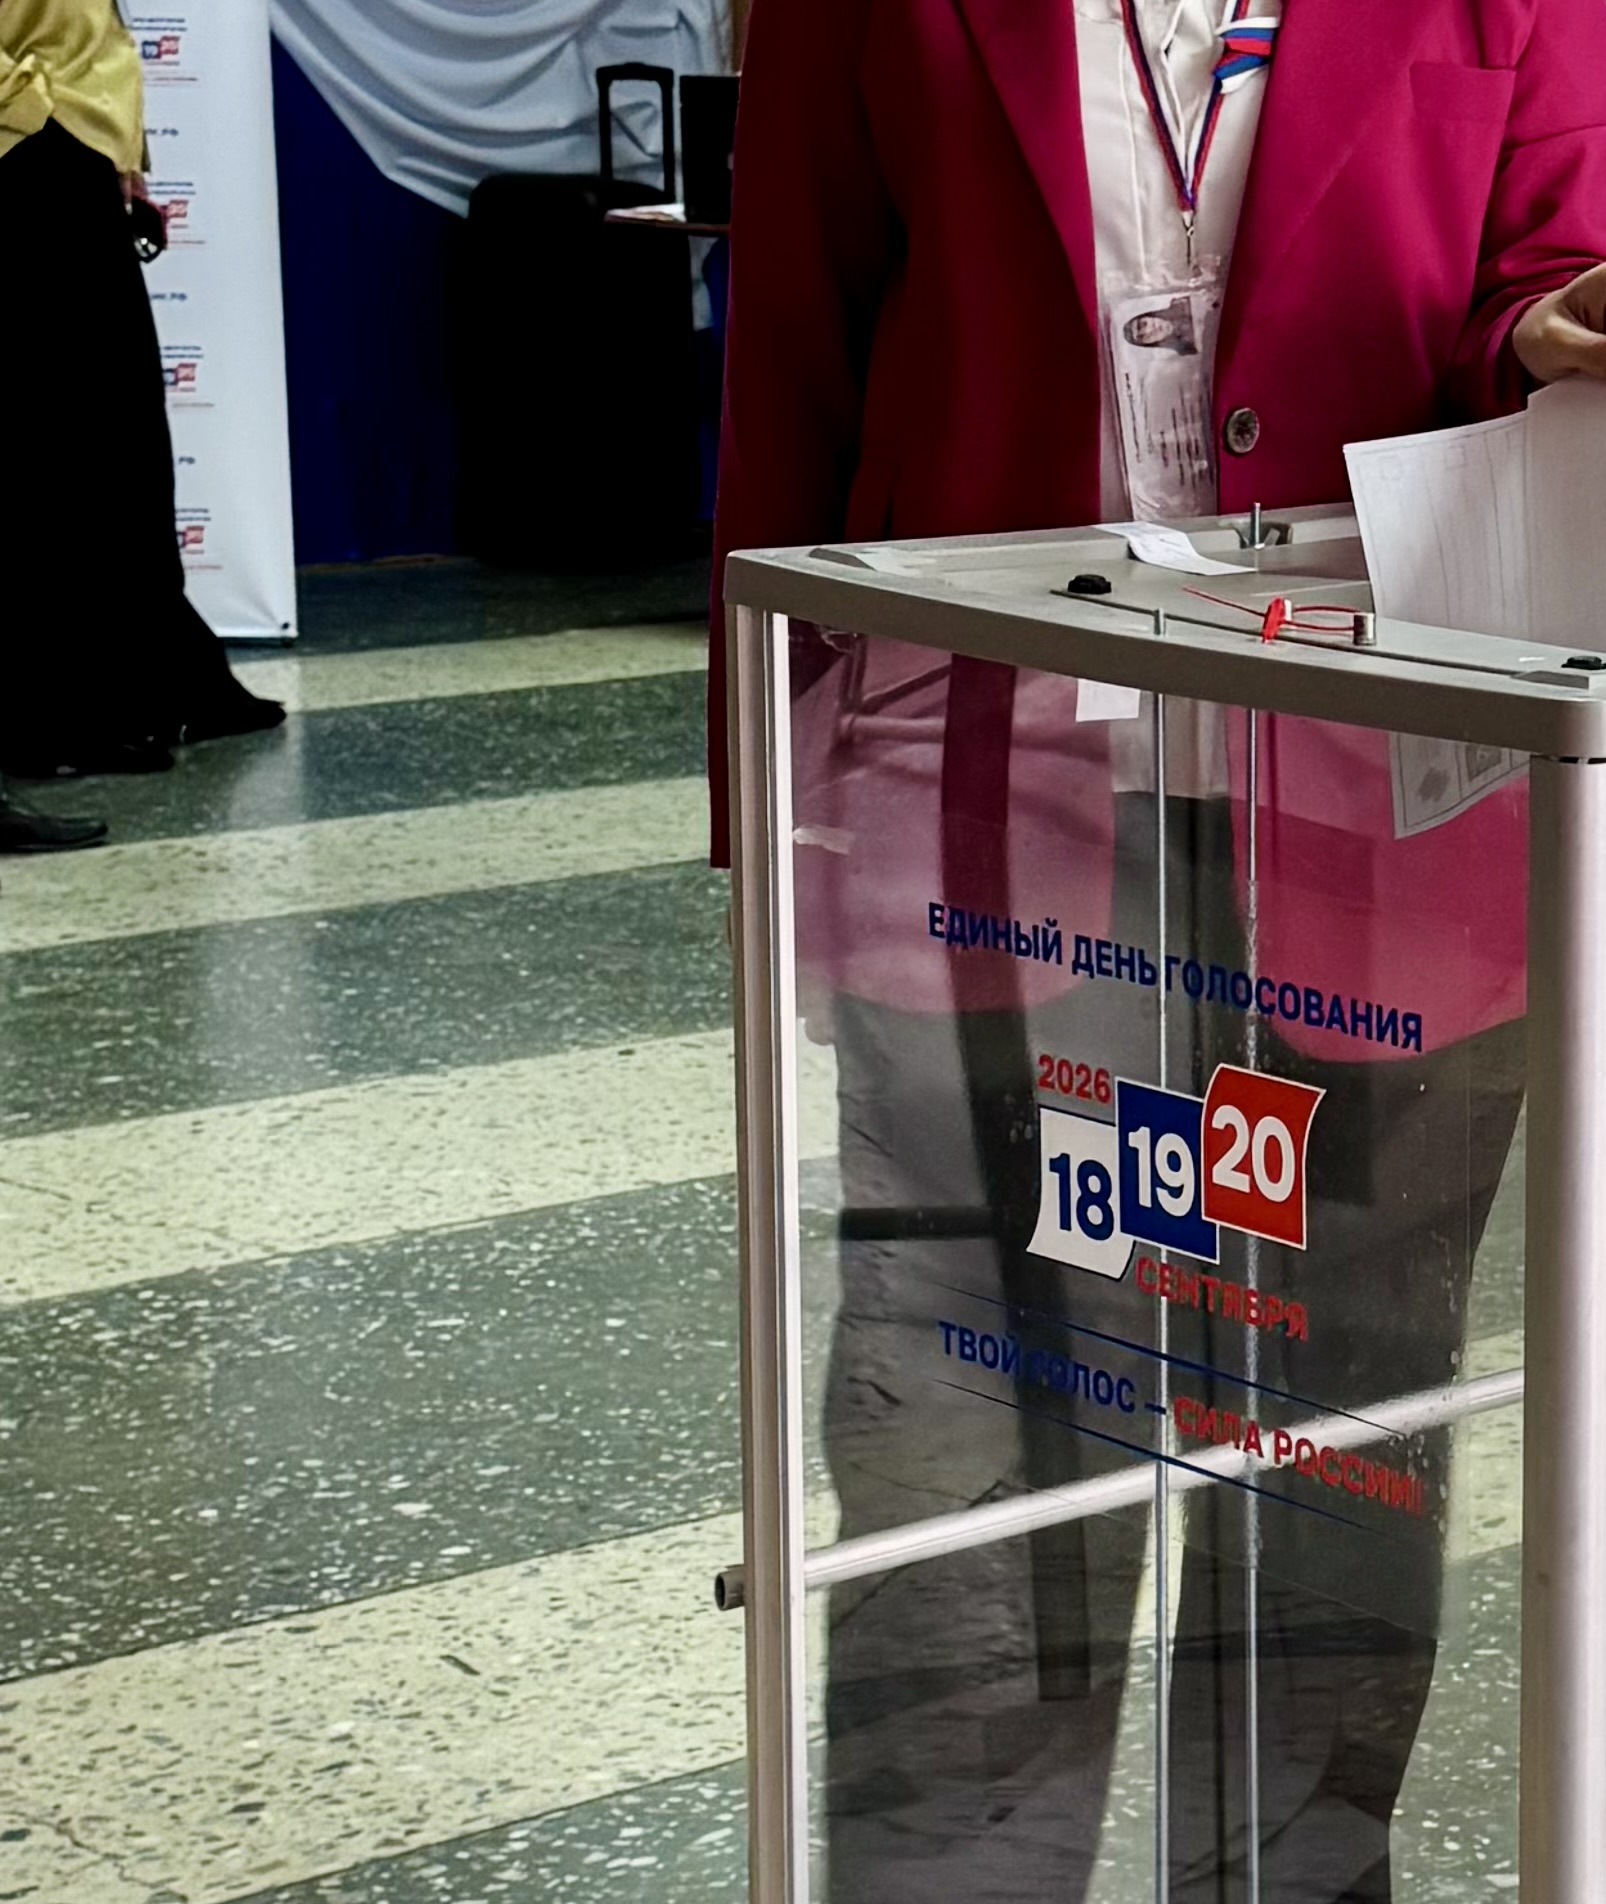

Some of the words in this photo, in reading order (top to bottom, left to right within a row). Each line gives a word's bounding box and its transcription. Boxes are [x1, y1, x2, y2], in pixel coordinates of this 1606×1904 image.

[928, 902, 1063, 965] ЕДИНЫЙ
[1072, 935, 1158, 986] ДЕНЬ
[1165, 955, 1423, 1052] ГОЛОСОВАНИЯ
[1037, 1053, 1113, 1105] 2026
[1049, 1153, 1115, 1242] 18
[1128, 1125, 1196, 1217] 19
[1211, 1104, 1296, 1203] 20
[1134, 1255, 1309, 1342] СЕНТЯБРЯ
[938, 1319, 1020, 1378] ТВОЙ
[1027, 1348, 1136, 1414] ГОЛОС
[1172, 1396, 1264, 1459] СИЛА
[1274, 1429, 1426, 1516] РОССИИ!
